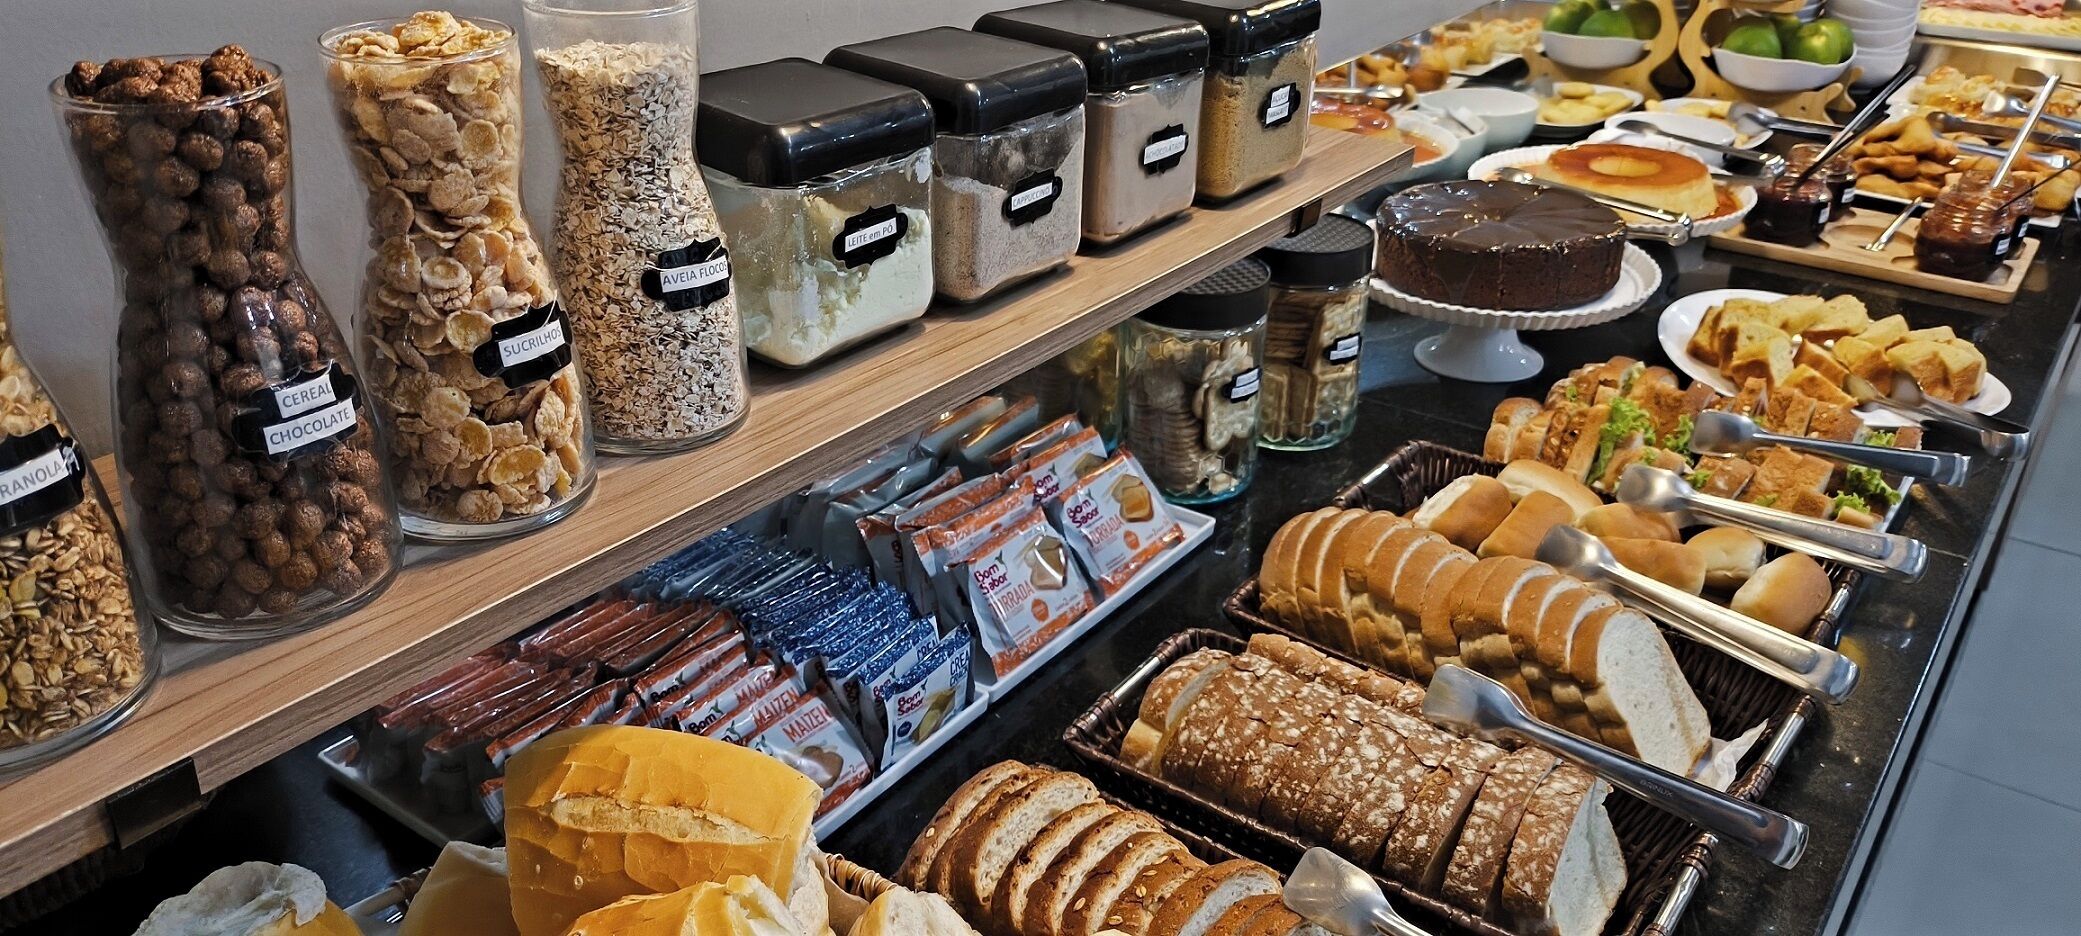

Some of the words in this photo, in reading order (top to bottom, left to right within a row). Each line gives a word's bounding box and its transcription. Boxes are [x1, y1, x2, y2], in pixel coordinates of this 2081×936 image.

[1012, 186, 1051, 207] CAPPUCCINO
[848, 233, 867, 247] LEITE
[869, 231, 881, 240] em
[882, 222, 893, 236] PÓ
[663, 270, 697, 285] AVEIA
[700, 260, 727, 279] FLOCOS
[503, 325, 562, 357] SUCRILHOS
[282, 383, 333, 408] CEREAL
[269, 407, 351, 445] CHOCOLATE
[1066, 499, 1092, 519] Bom
[973, 563, 1000, 583] Bom
[980, 572, 1008, 596] Sabor
[897, 690, 921, 707] Bom
[688, 712, 718, 734] Bom
